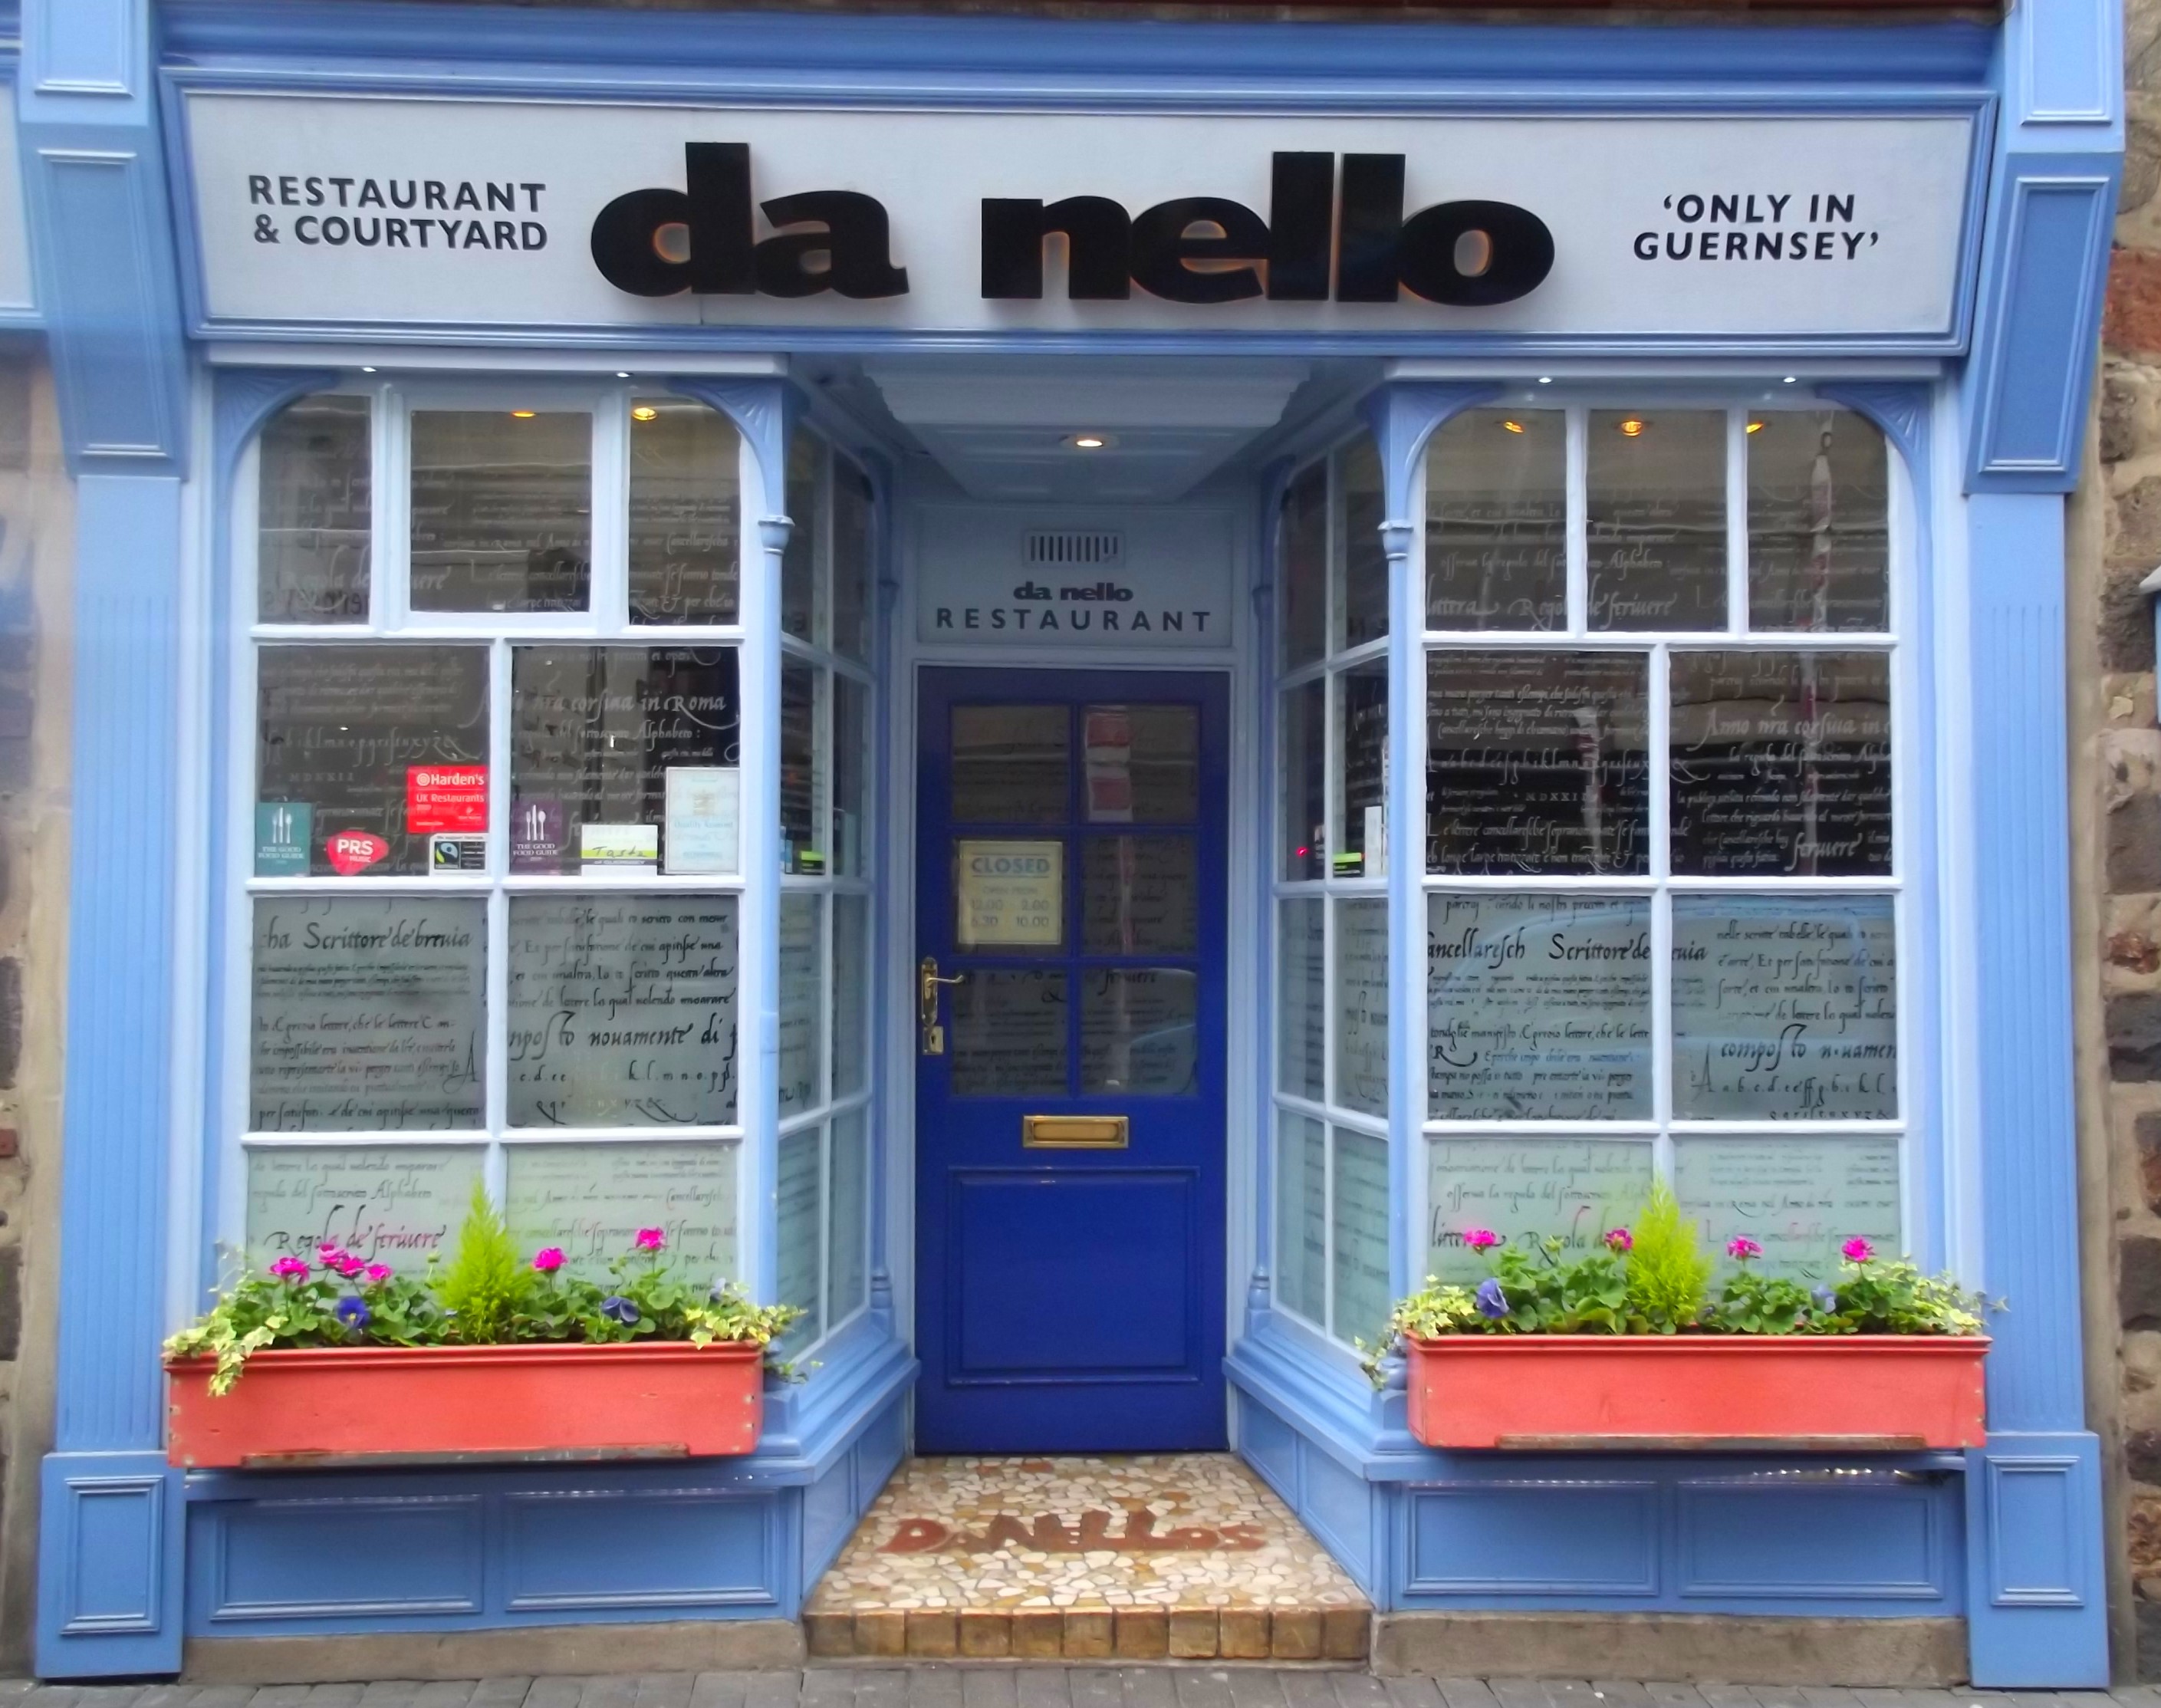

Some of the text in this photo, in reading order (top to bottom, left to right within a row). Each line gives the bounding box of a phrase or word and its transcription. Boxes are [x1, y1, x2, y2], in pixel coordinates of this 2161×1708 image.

[248, 175, 548, 212] RESTAURANT
[1809, 194, 1856, 224] IN
[254, 214, 548, 252] & COURTYARD
[590, 141, 1556, 307] da nello
[1013, 581, 1134, 602] da nello
[936, 607, 1212, 632] RESTAURANT
[431, 772, 485, 786] Harden's
[416, 793, 485, 803] UK Restaurants
[337, 838, 374, 855] PRS
[971, 857, 1051, 874] CLOSED
[1016, 915, 1050, 927] 10.00
